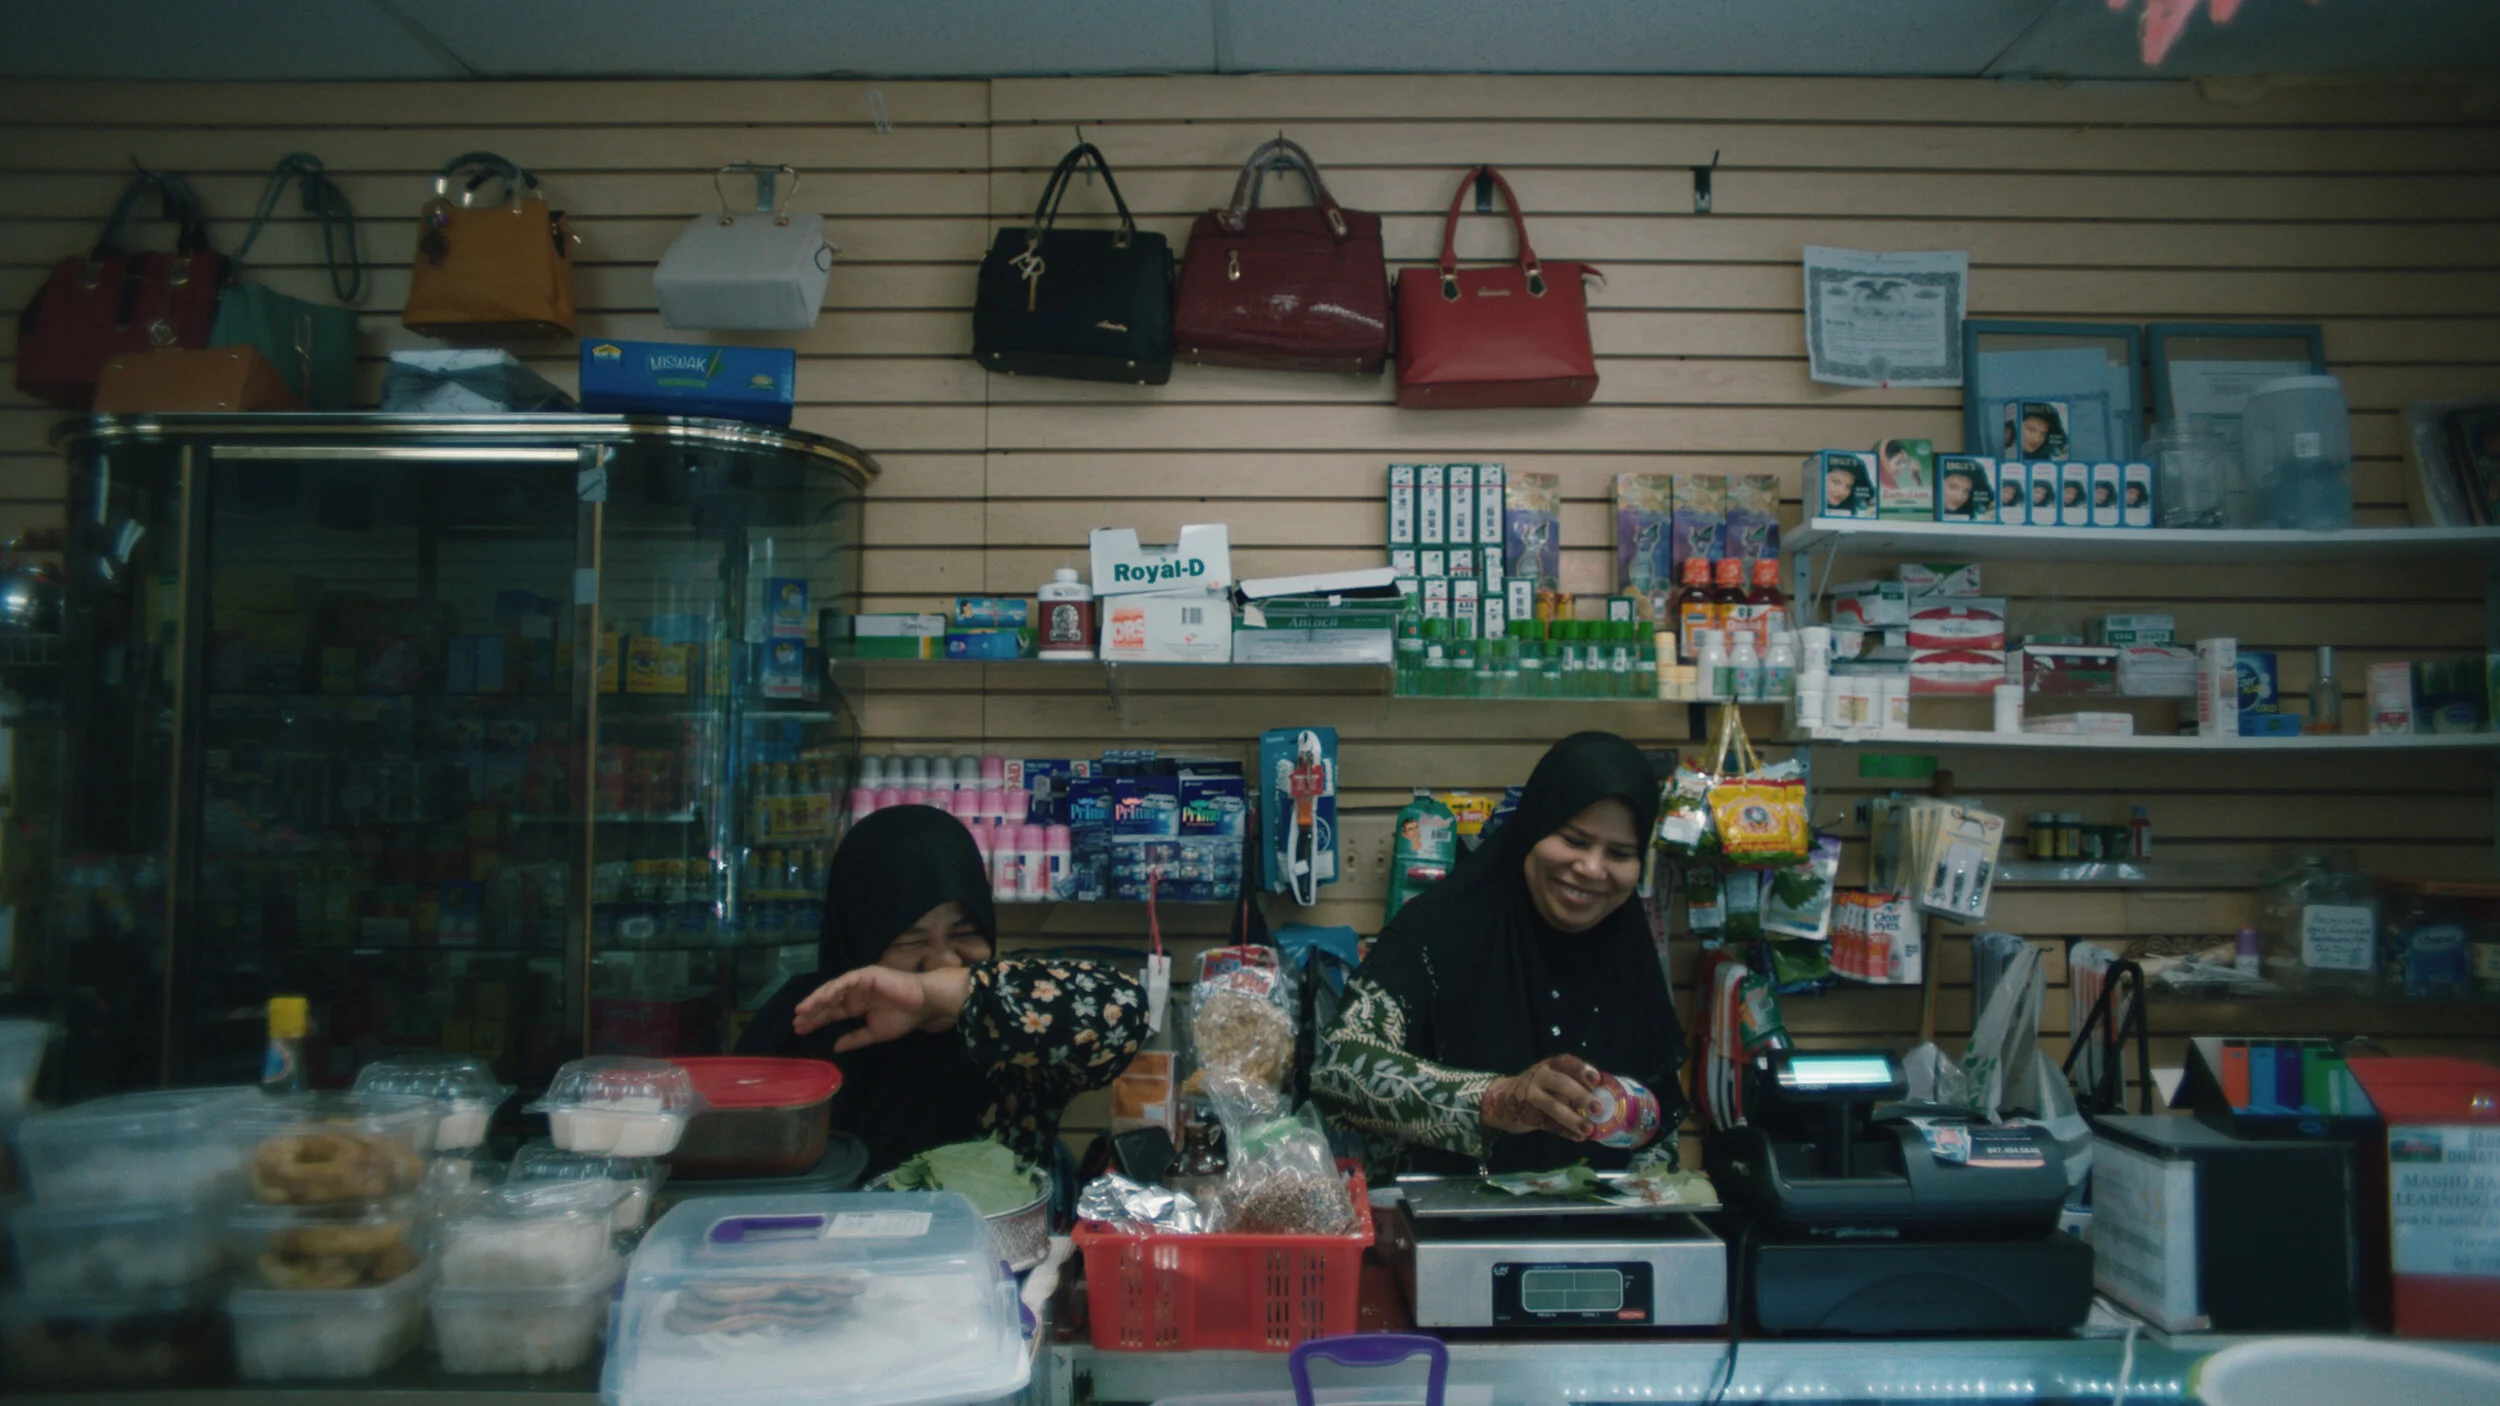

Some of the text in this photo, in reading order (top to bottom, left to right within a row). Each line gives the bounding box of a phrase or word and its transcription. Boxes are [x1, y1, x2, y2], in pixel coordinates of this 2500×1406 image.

[650, 354, 707, 372] MISWAK
[1114, 558, 1205, 584] Royal-D
[1873, 912, 1901, 922] Clear
[2396, 1193, 2489, 1208] LEARNING
